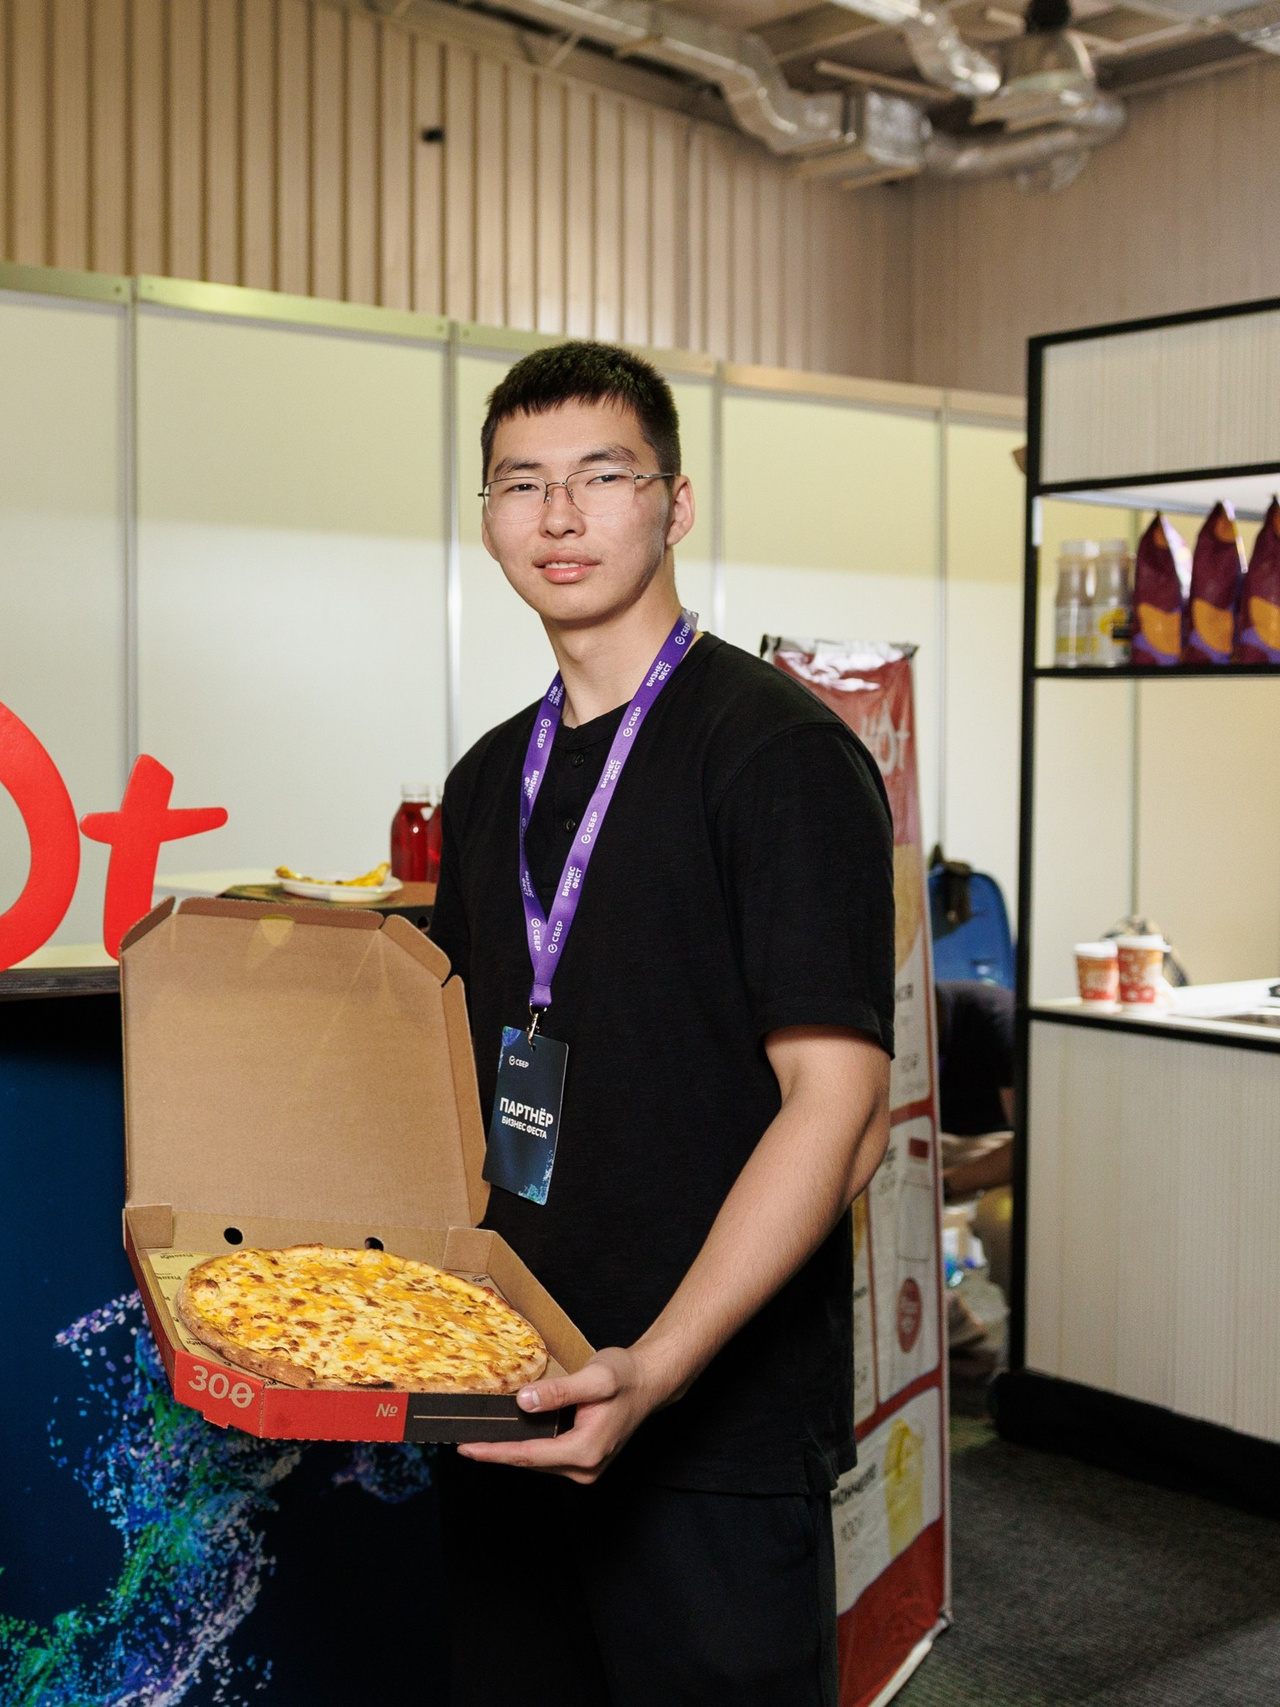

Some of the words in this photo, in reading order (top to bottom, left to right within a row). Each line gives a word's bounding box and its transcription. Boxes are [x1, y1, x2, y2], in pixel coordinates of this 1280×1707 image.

[646, 660, 666, 687] БИЗНЕС
[658, 663, 672, 681] ФЕСТ
[628, 706, 641, 727] СБЕР
[537, 728, 547, 749] СБЕР
[600, 759, 616, 789] БИЗНЕС
[610, 760, 622, 780] ФЕСТ
[586, 811, 598, 833] СБЕР
[562, 866, 576, 897] БИЗНЕС
[572, 868, 582, 889] ФЕСТ
[533, 929, 541, 952] СБЕР
[552, 920, 563, 943] СБЕР
[515, 1058, 529, 1069] СБЕР
[499, 1096, 554, 1128] ПАРТНЁР
[501, 1116, 527, 1132] БИЗНЕС
[526, 1124, 547, 1140] ФЕСТА
